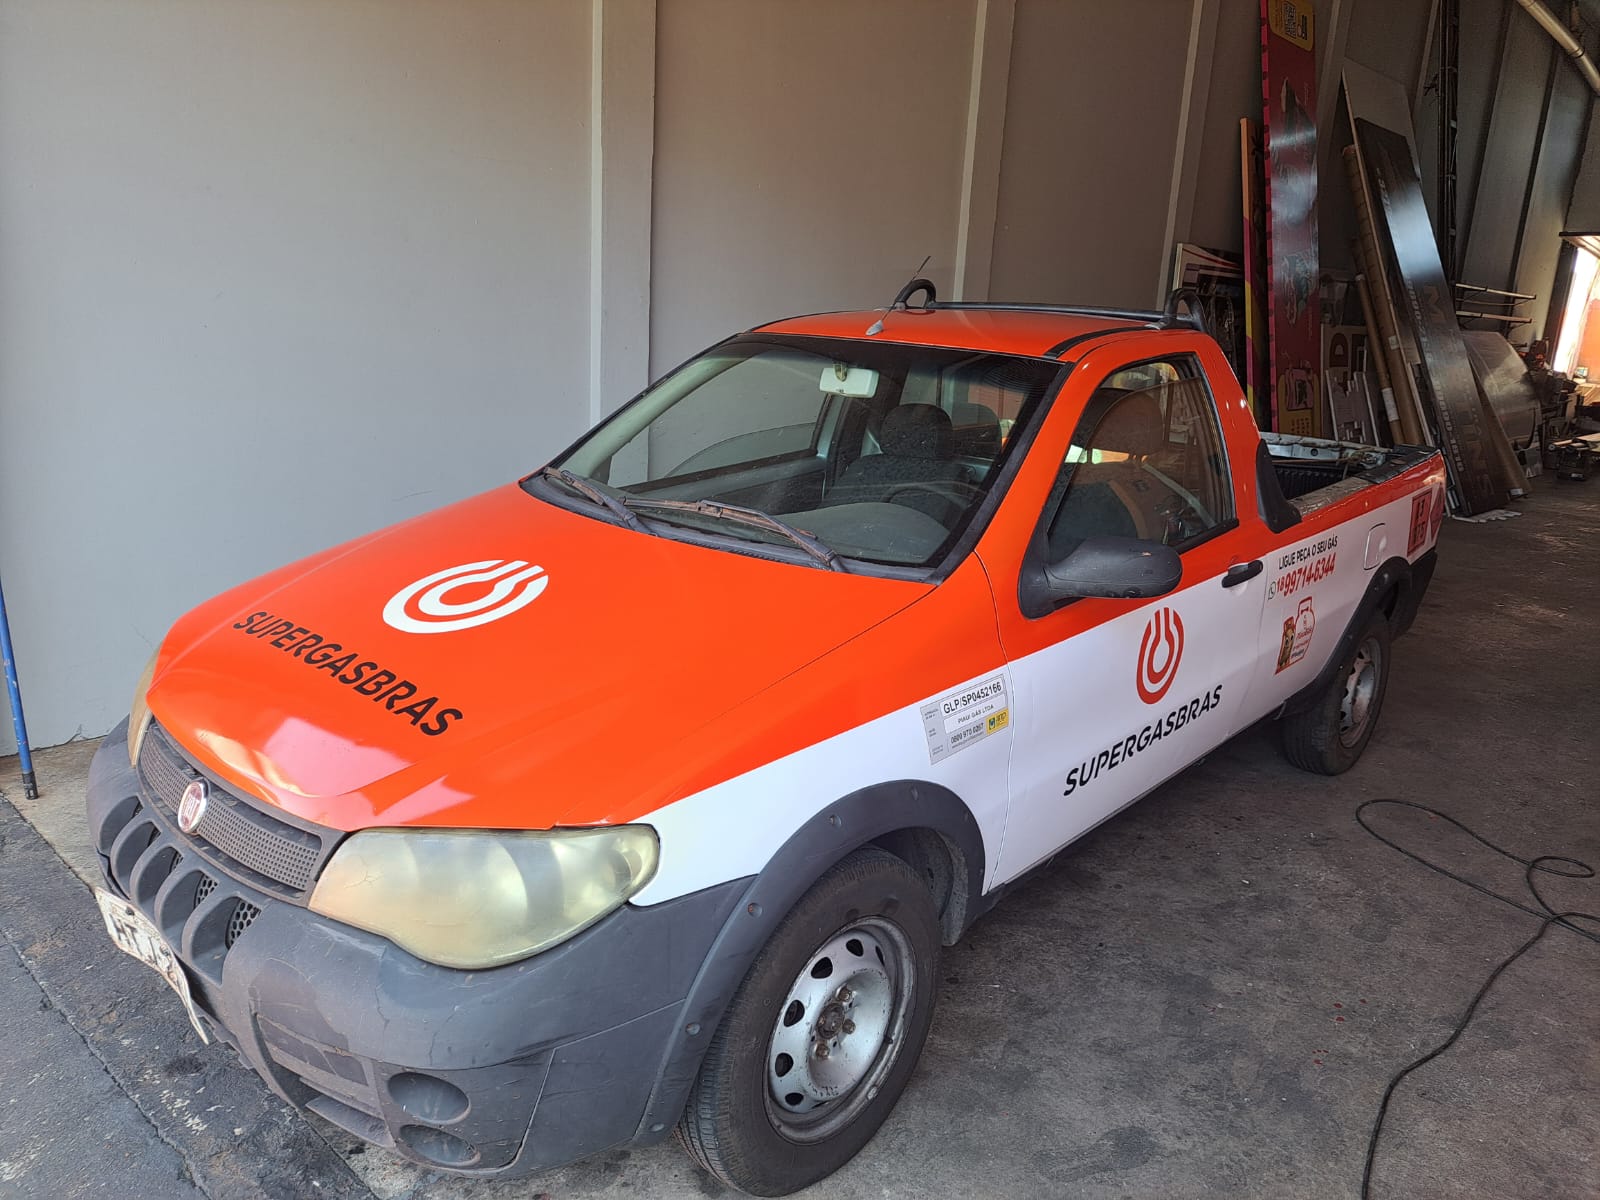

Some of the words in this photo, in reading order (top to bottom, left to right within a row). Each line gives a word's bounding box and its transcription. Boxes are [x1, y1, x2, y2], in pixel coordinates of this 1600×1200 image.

[1279, 551, 1296, 570] LIGUE
[1296, 546, 1311, 562] PEÇA
[1311, 543, 1317, 556] O
[1317, 538, 1328, 555] SEU
[1327, 533, 1338, 549] GÁS
[232, 611, 464, 737] SUPERGASBRAS
[943, 681, 1002, 714] GLP/SP0452166
[1063, 684, 1223, 797] SUPERGASBRAS
